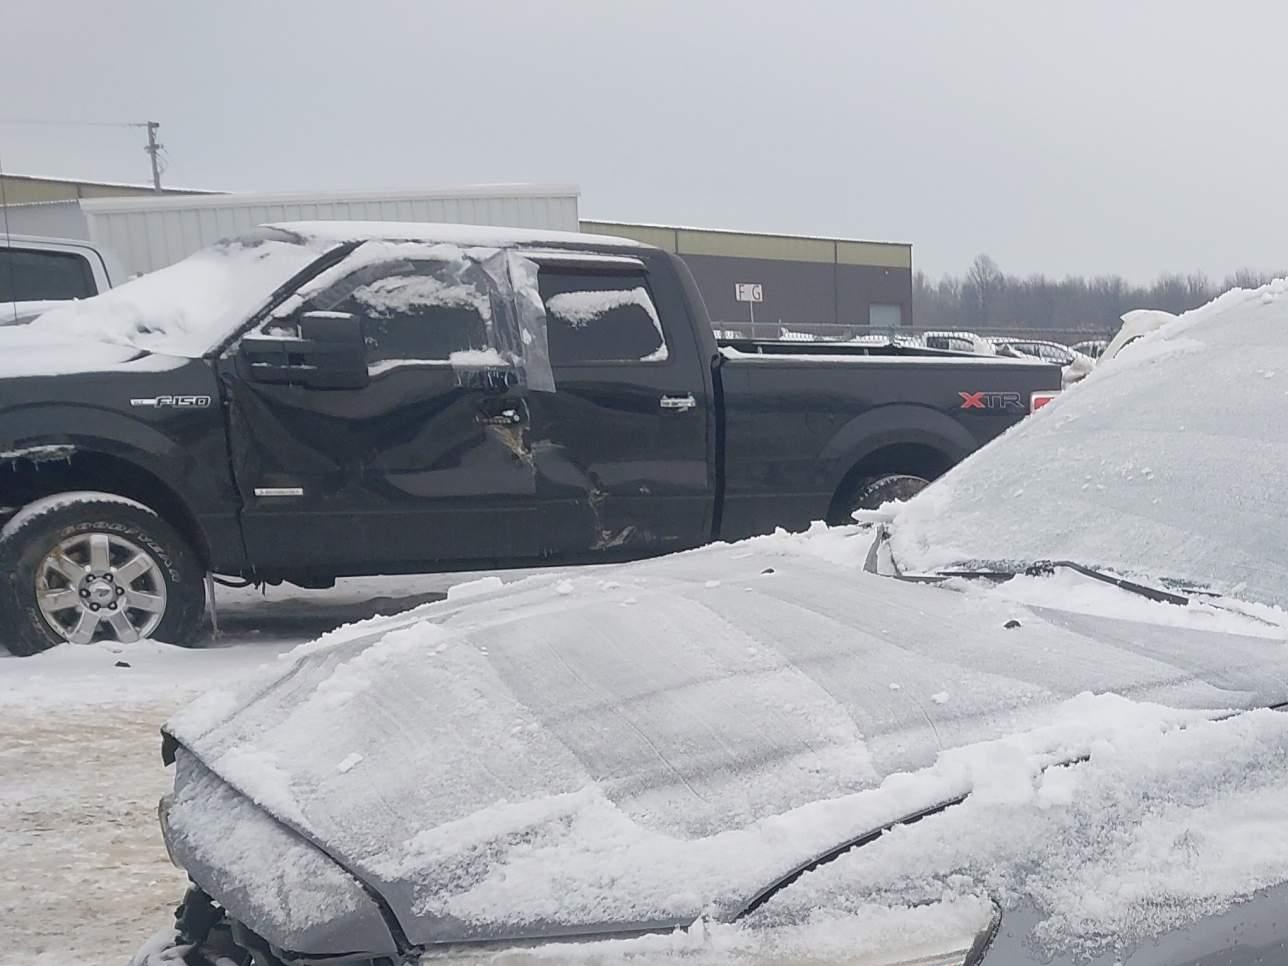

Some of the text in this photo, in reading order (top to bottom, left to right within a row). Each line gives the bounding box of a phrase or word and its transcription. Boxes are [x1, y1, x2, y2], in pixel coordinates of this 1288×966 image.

[738, 284, 761, 300] F G
[958, 391, 1025, 409] XTR
